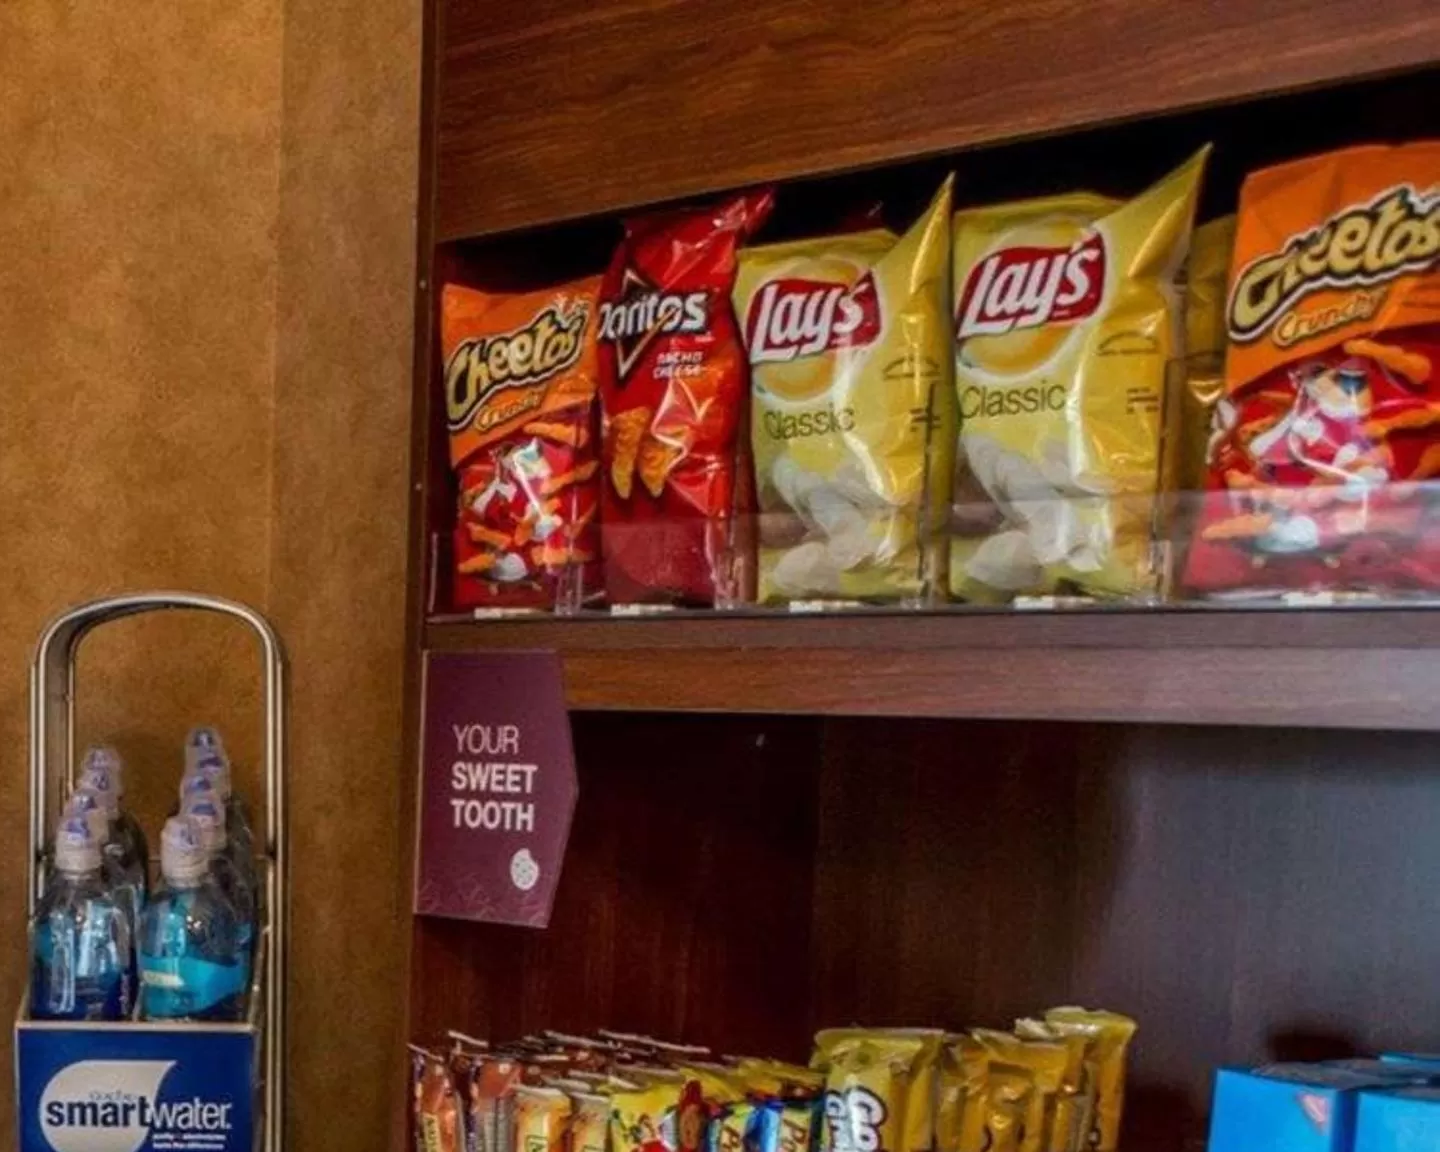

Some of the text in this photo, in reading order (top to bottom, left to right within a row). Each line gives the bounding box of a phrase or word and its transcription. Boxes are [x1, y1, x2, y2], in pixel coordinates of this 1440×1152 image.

[1233, 192, 1440, 331] Cheetos
[960, 244, 1097, 338] Lay's
[752, 282, 867, 362] Lay's
[448, 307, 587, 412] Cheetos
[959, 383, 1067, 420] Classic
[764, 405, 856, 441] Classic
[452, 724, 520, 754] YOUR
[451, 761, 538, 793] SWEET
[450, 799, 534, 832] TOOTH
